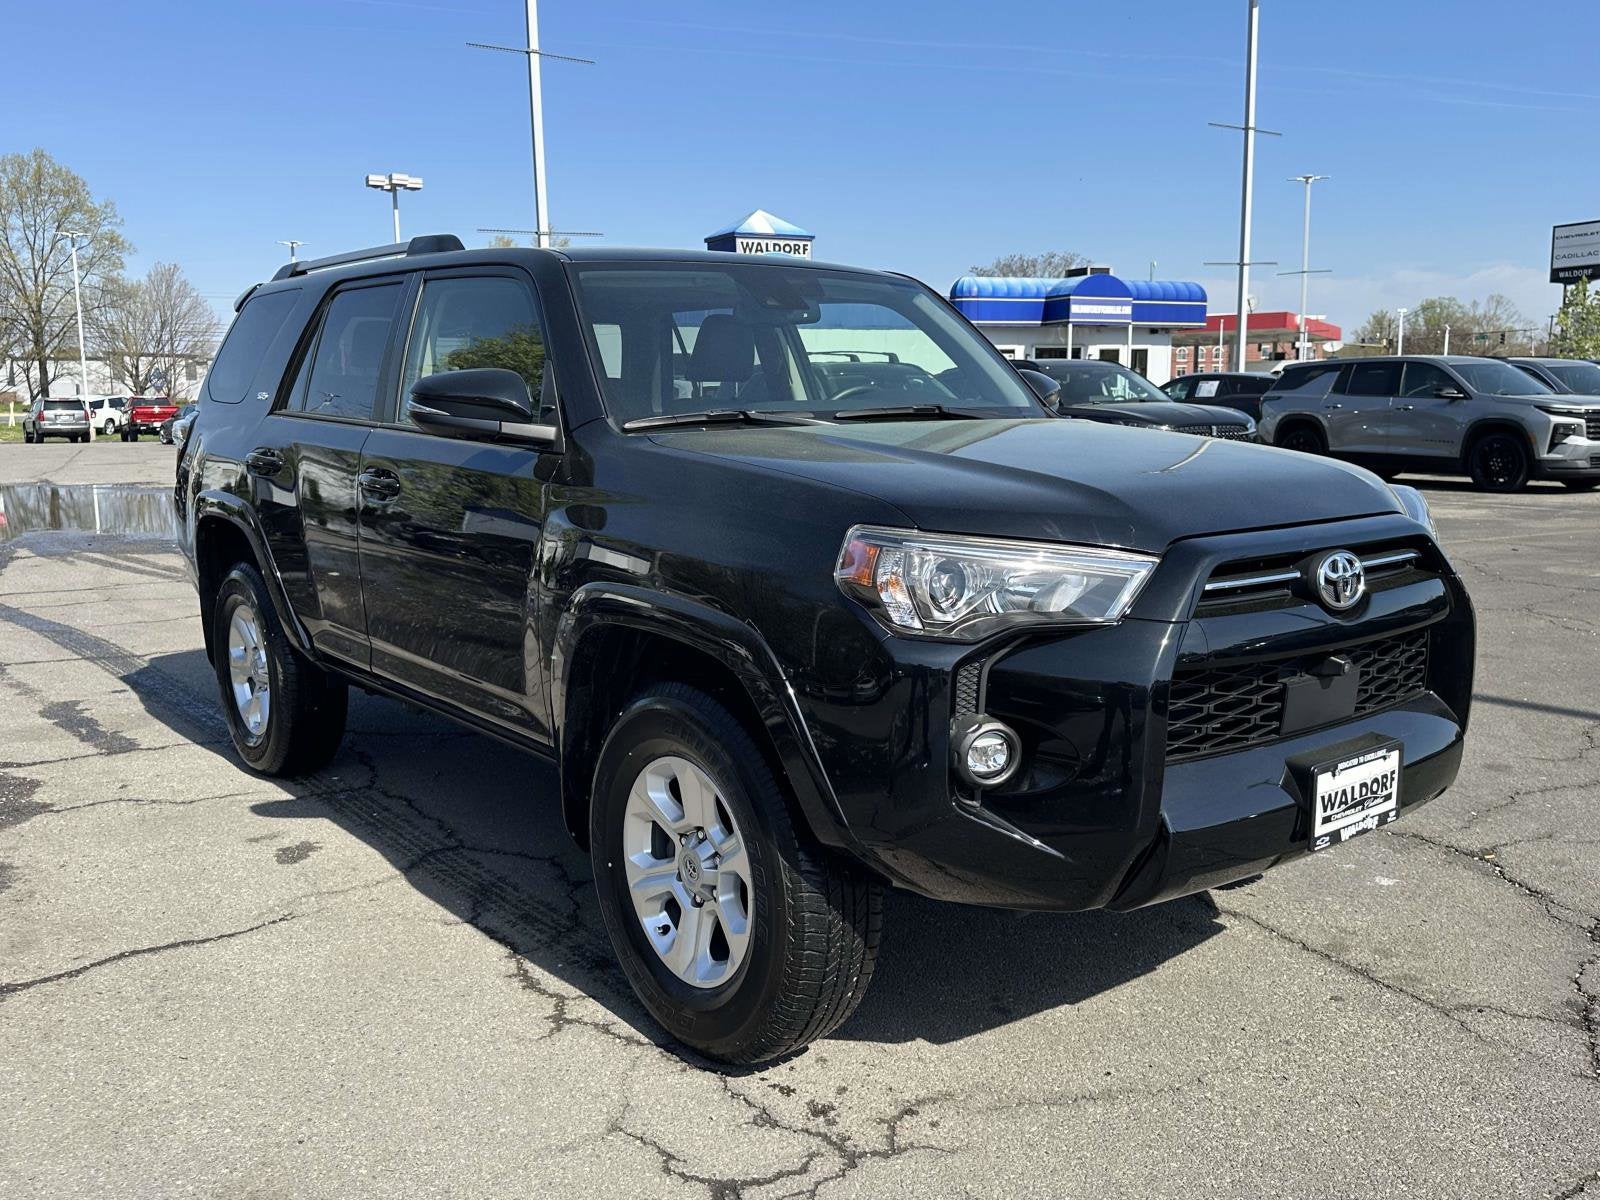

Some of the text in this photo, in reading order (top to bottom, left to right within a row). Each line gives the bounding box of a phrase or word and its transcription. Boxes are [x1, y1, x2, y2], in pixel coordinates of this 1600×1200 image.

[741, 241, 809, 254] WALDORF
[1555, 250, 1599, 260] CADILLAC
[1559, 268, 1593, 278] WALDORF
[1320, 770, 1396, 814] WALDORF
